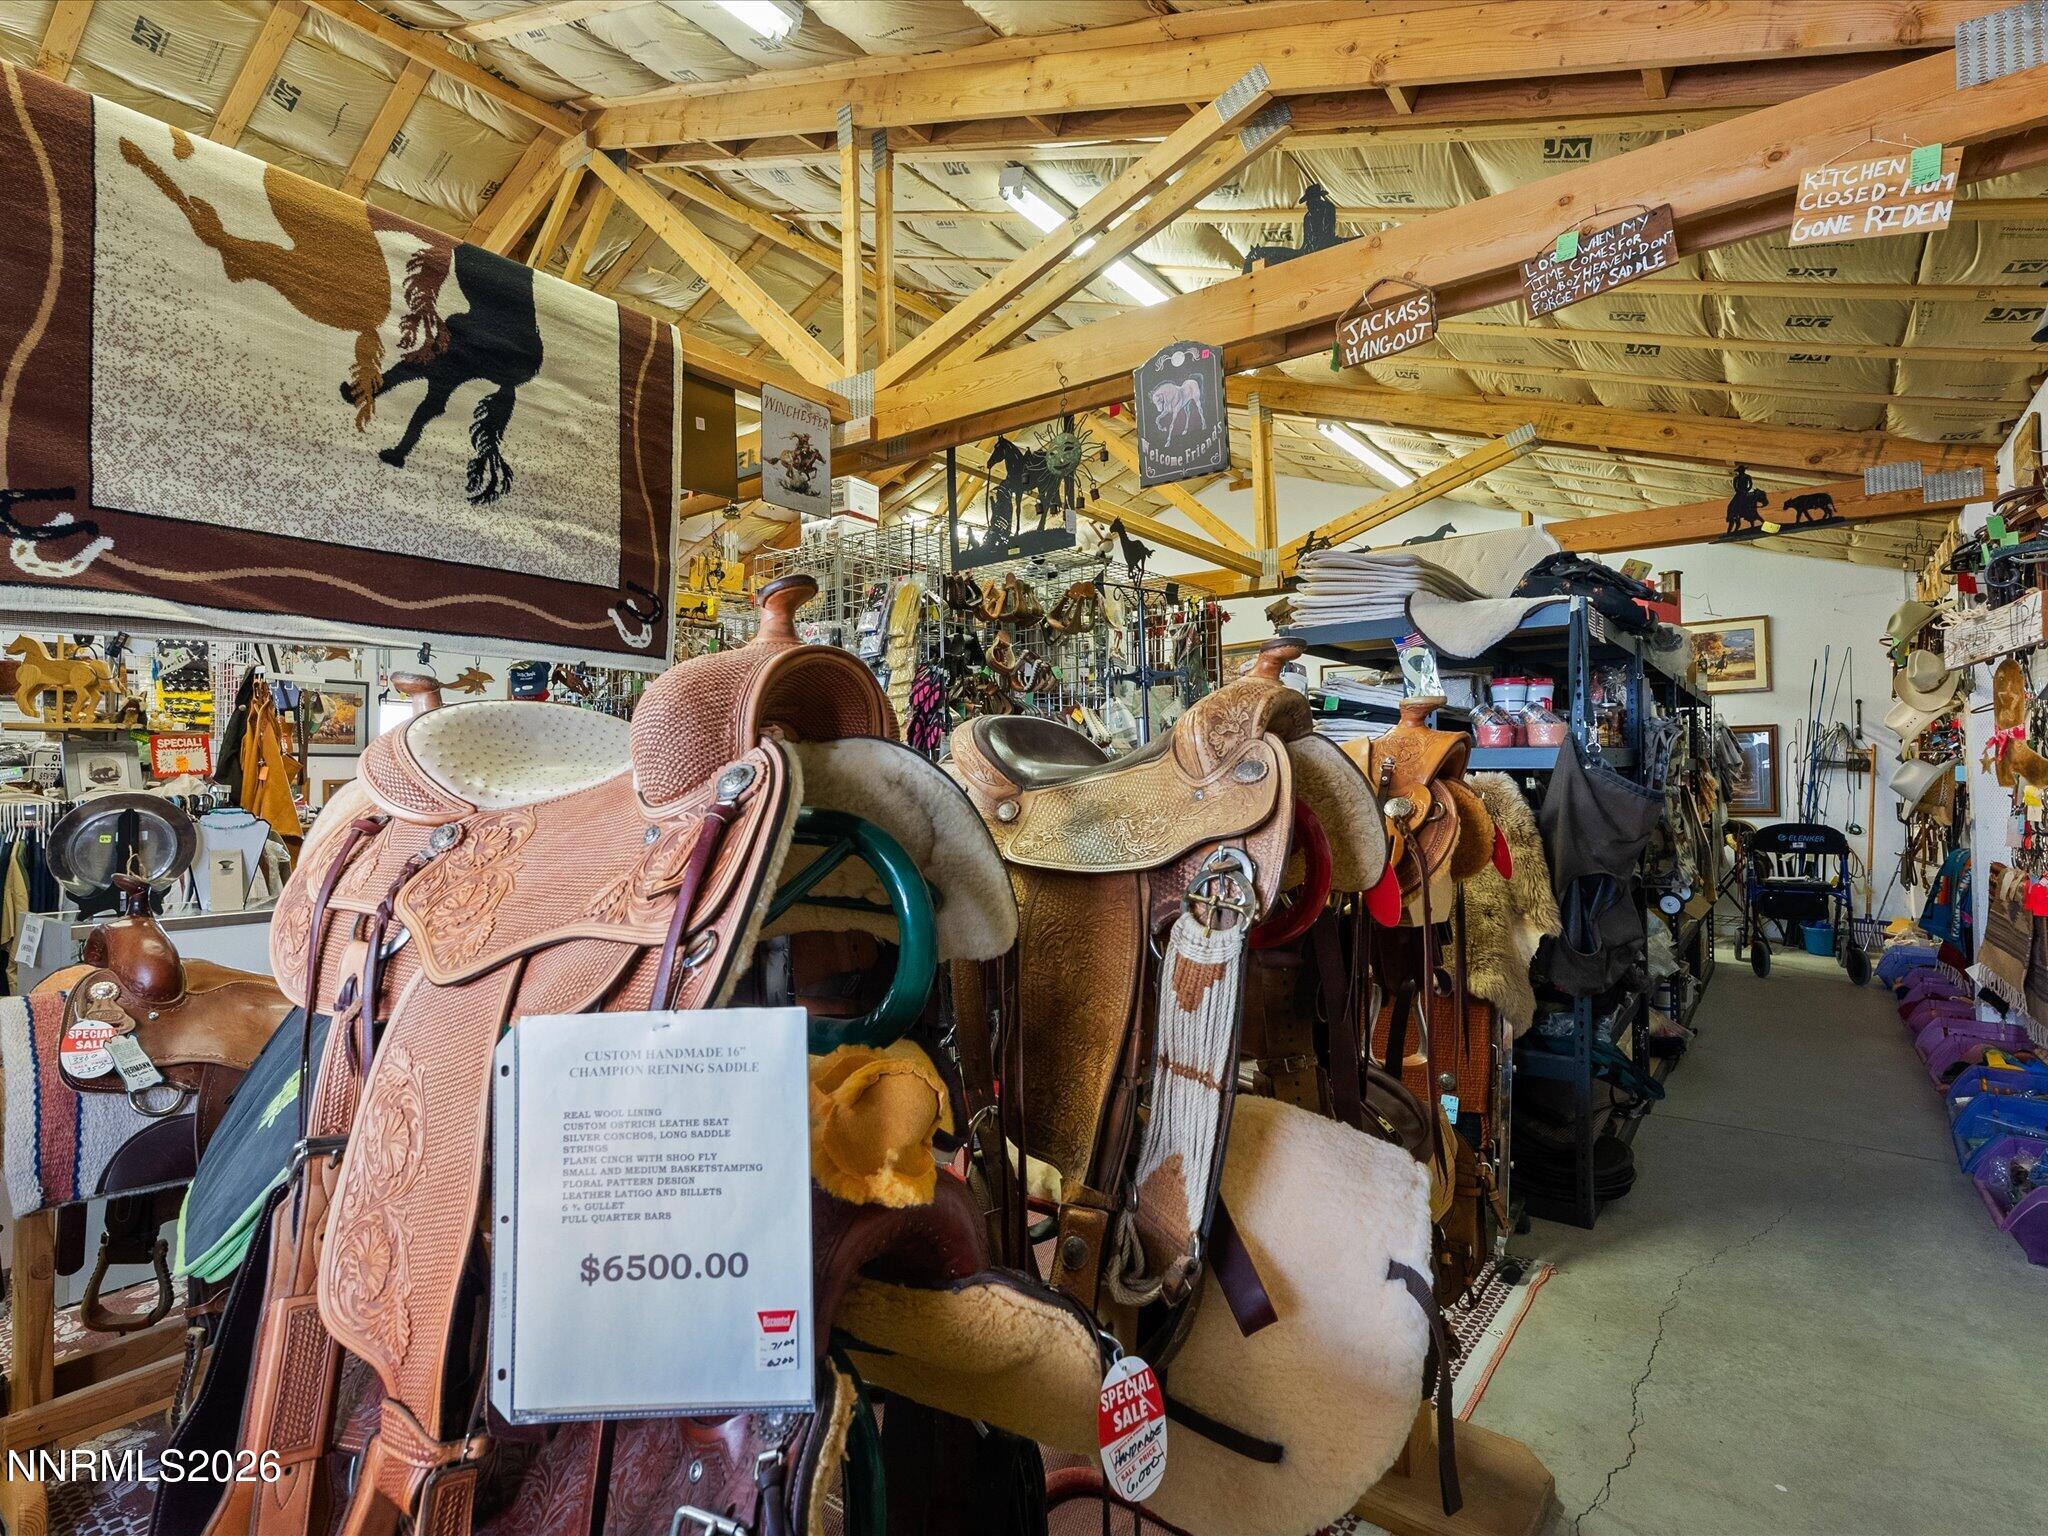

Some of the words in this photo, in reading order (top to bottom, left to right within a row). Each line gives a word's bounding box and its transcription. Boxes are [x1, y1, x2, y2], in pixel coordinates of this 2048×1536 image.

[1543, 137, 1593, 159] JM
[1804, 157, 1907, 191] KITCHEN
[1791, 215, 1855, 242] GONE
[1864, 200, 1953, 234] RIDEN
[1525, 250, 1558, 278] LOR
[1577, 228, 1616, 255] WHEN
[1621, 214, 1649, 235] MY
[1525, 267, 1567, 291] TIME
[1569, 244, 1617, 272] COMES
[1618, 233, 1642, 250] FOR
[1531, 273, 1583, 301] COWBOY
[1532, 285, 1581, 316] FORGET
[1583, 274, 1605, 294] MY
[1608, 251, 1666, 286] SADDLE
[1343, 295, 1430, 346] JACKASS
[1985, 307, 2046, 321] JM
[1345, 322, 1432, 365] HANGOUT
[1625, 344, 1661, 357] JM
[764, 394, 829, 431] WINCHESTER
[1141, 437, 1183, 468] Welcome
[1185, 420, 1223, 465] Friends
[156, 738, 202, 748] SPECIAL!
[1788, 834, 1825, 843] ELENKER
[68, 1029, 115, 1040] SPECIAL
[584, 1049, 642, 1063] CUSTOM
[645, 1046, 723, 1060] HANDMADE
[569, 1063, 645, 1078] CHAMPION
[647, 1062, 704, 1075] REINING
[707, 1061, 760, 1074] SADDLE
[563, 1111, 591, 1120] REAL
[593, 1109, 625, 1119] WOOL
[626, 1108, 663, 1117] LINING
[563, 1121, 607, 1131] CUSTOM
[609, 1119, 656, 1130] OSTRICH
[659, 1118, 700, 1128] LEATHE
[702, 1117, 730, 1127] SEAT
[562, 1132, 601, 1142] SILVER
[603, 1131, 658, 1142] CONCHOS,
[660, 1130, 688, 1139] LONG
[690, 1128, 732, 1139] SADDLE
[562, 1144, 609, 1154] STRINGS
[563, 1155, 599, 1165] FLANK
[600, 1154, 635, 1164] CINCH
[636, 1153, 663, 1163] WITH
[666, 1152, 695, 1162] SHOO
[697, 1151, 718, 1161] FLY
[562, 1166, 598, 1177] SMALL
[600, 1165, 623, 1175] AND
[624, 1164, 668, 1175] MEDIUM
[670, 1162, 764, 1173] BASKETSTAMPING
[562, 1178, 604, 1189] FLORAL
[605, 1176, 654, 1188] PATTERN
[657, 1175, 696, 1186] DESIGN
[562, 1189, 612, 1200] LEATHER
[614, 1188, 653, 1199] LATIGO
[655, 1187, 678, 1198] AND
[680, 1187, 723, 1197] BILLETS
[561, 1203, 569, 1212] 6
[584, 1201, 626, 1212] GULLET
[561, 1214, 588, 1224] FULL
[591, 1212, 642, 1224] QUARTER
[644, 1211, 672, 1221] BARS
[580, 1252, 749, 1286] $6500.00
[1100, 1370, 1155, 1413] SPECIAL
[1113, 1399, 1149, 1433] SALE
[1120, 1464, 1137, 1481] SALE
[1139, 1445, 1158, 1466] PRICE
